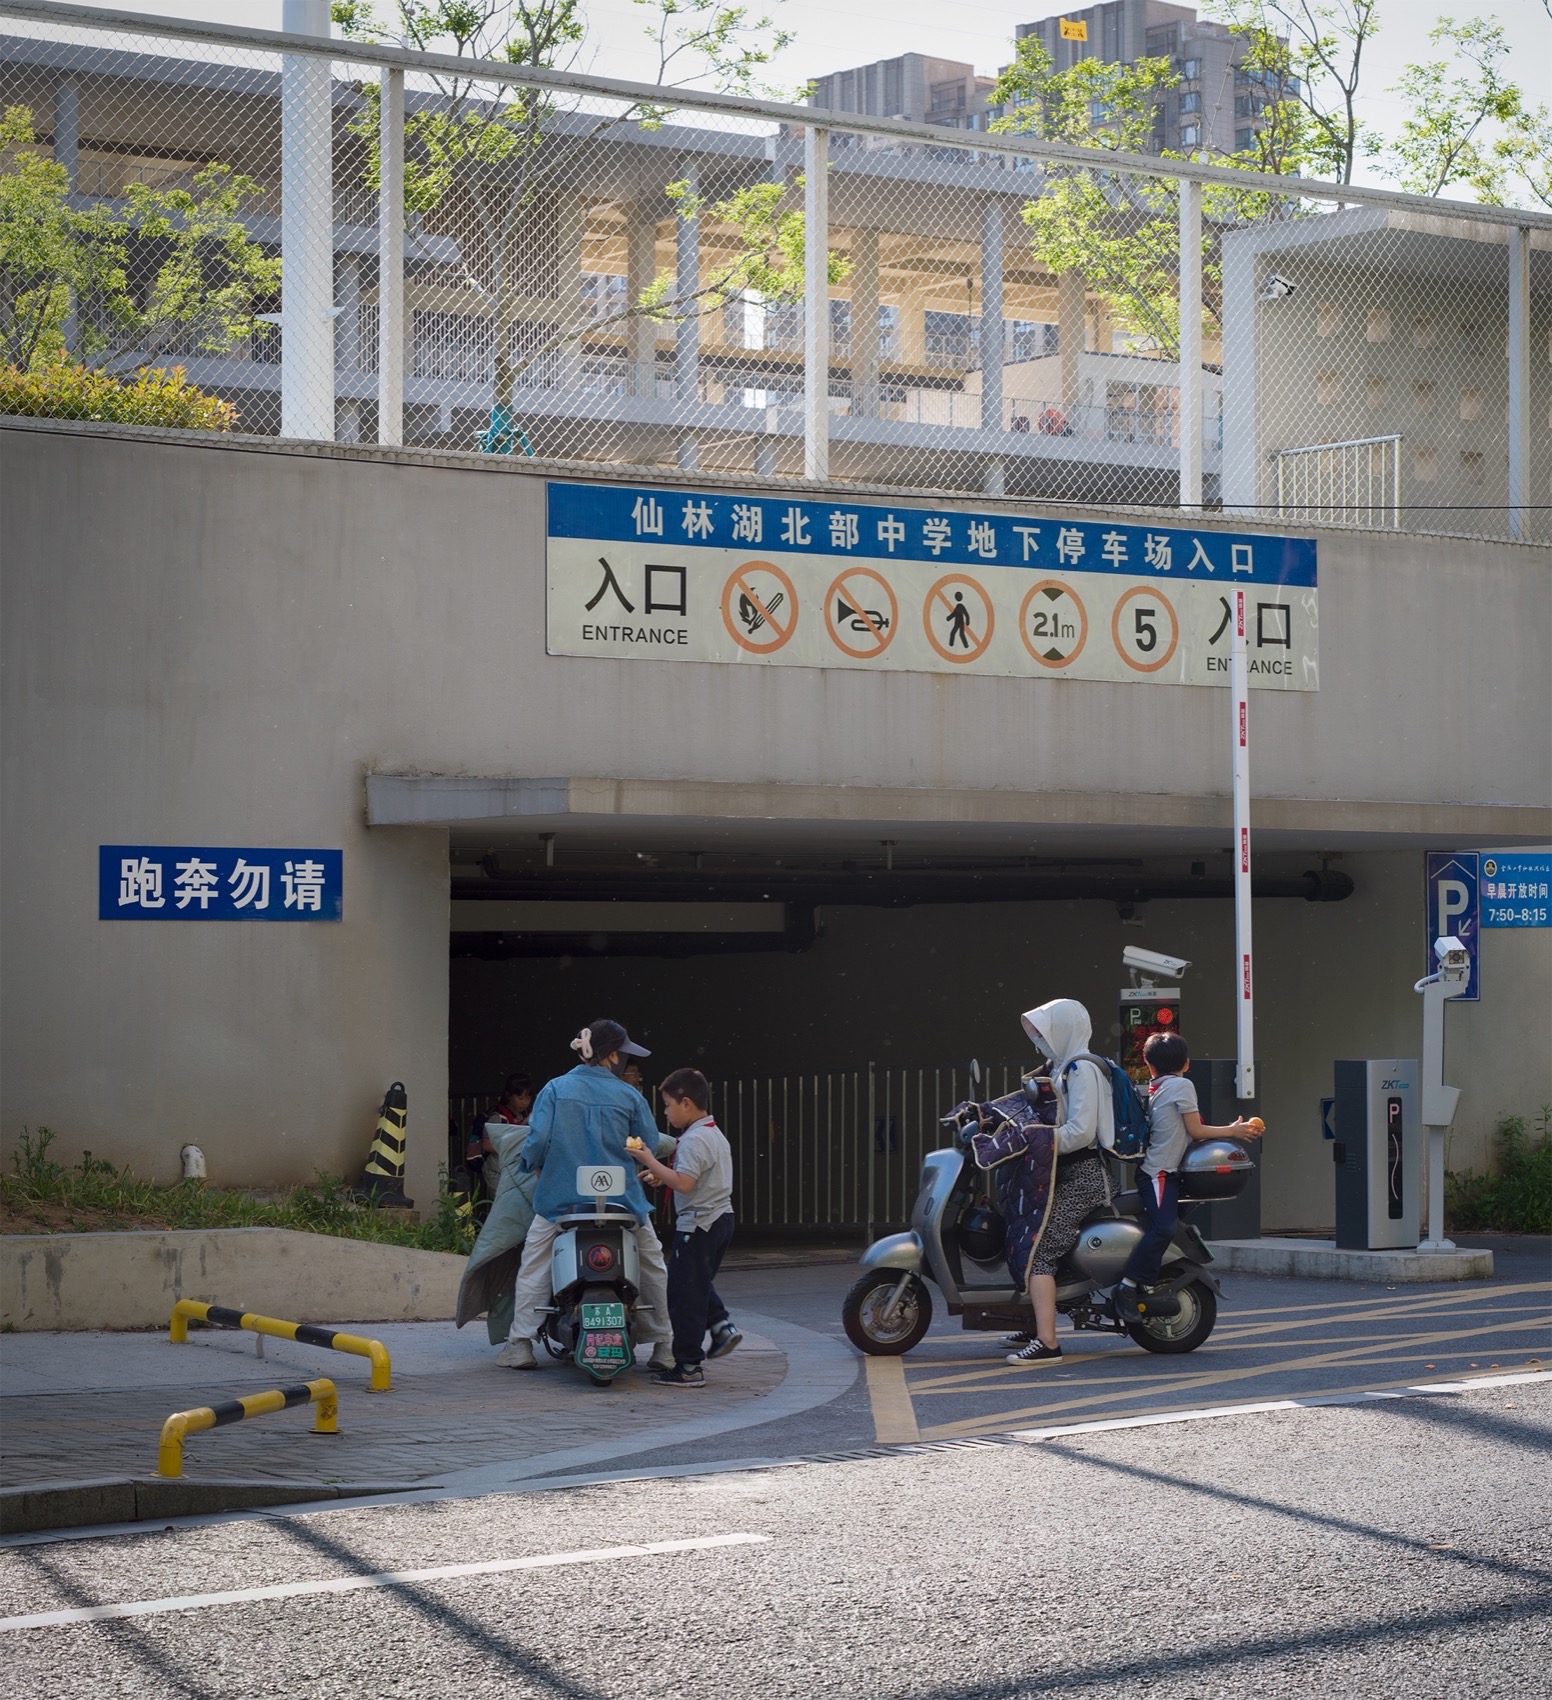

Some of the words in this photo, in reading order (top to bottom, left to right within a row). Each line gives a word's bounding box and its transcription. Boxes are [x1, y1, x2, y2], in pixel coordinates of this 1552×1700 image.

[630, 496, 1254, 574] 仙林湖北部中学地下停车场入口
[584, 556, 687, 617] 入口
[582, 624, 689, 645] ENTRANCE
[1033, 611, 1075, 639] 2.1m
[1135, 608, 1157, 652] 5
[1207, 657, 1293, 675] ENANCE
[1486, 882, 1549, 899] 早晨开放时间
[1437, 879, 1469, 937] P
[1389, 1103, 1400, 1123] P
[584, 1316, 622, 1327] B491307
